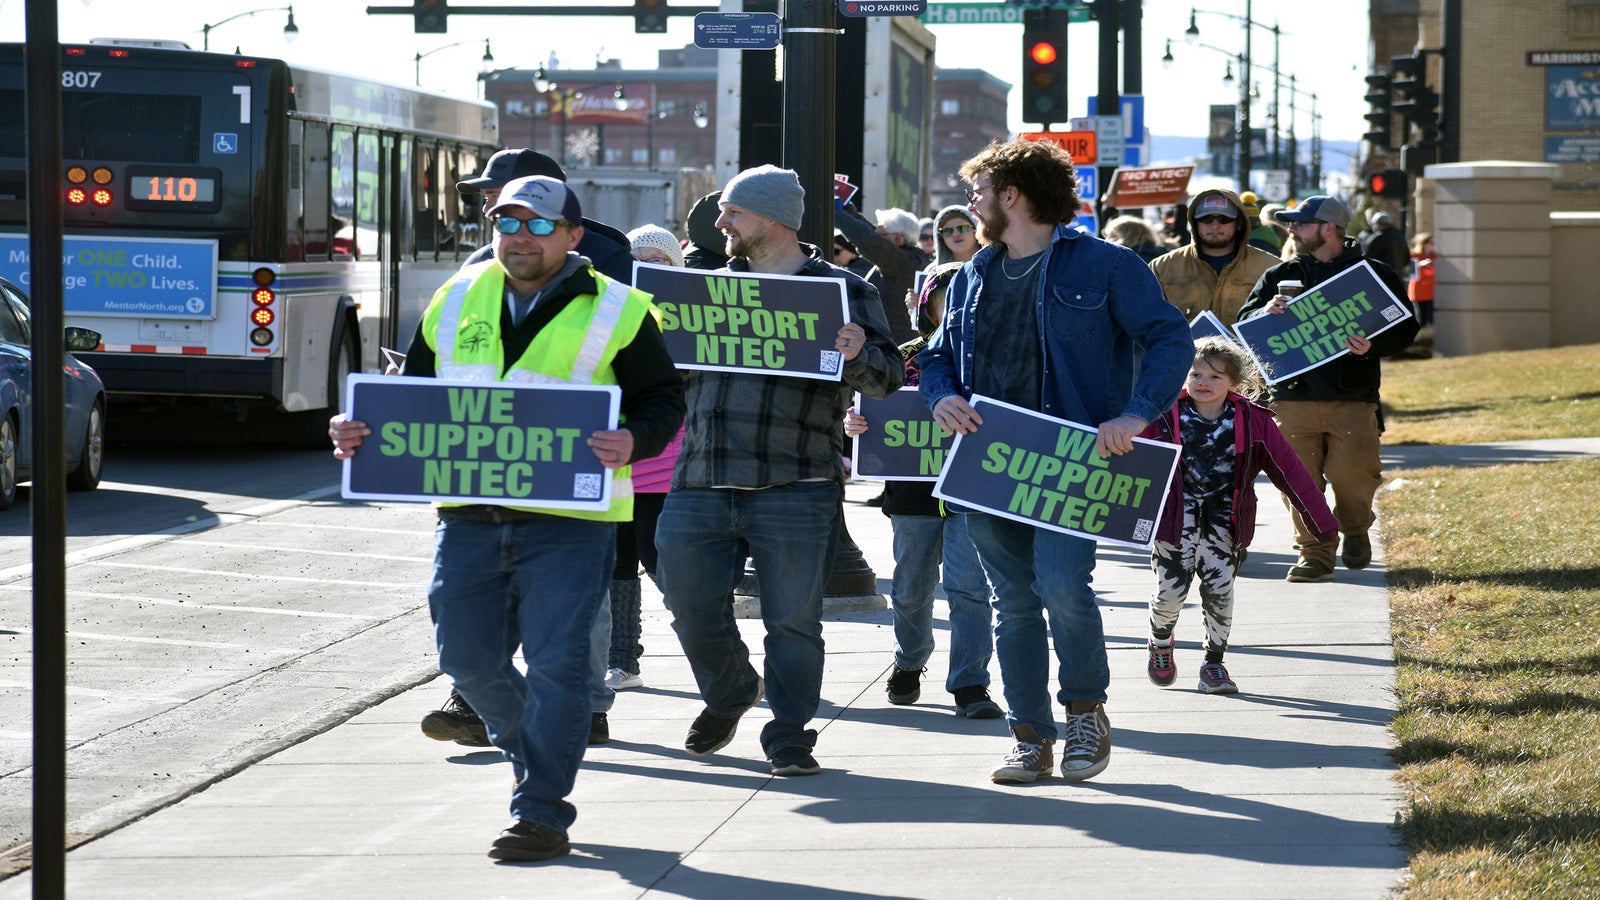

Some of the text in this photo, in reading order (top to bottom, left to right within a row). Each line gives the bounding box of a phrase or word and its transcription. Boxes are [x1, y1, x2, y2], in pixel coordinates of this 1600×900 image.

[860, 4, 919, 12] NO PARKING
[927, 4, 1025, 22] Hammo
[1532, 52, 1600, 64] HARRINGT
[61, 71, 102, 88] 807
[148, 176, 198, 201] 110
[1122, 171, 1147, 181] NO
[78, 249, 129, 267] ONE
[132, 254, 182, 269] Child.
[91, 270, 148, 289] TWO
[152, 276, 199, 290] Lives.
[704, 276, 762, 307] WE
[104, 301, 184, 313] MentorNorth.org
[656, 302, 819, 340] SUPPORT
[1288, 290, 1331, 322] WE
[1266, 290, 1373, 355] SUPPORT
[696, 334, 786, 369] NTEC
[1301, 321, 1366, 364] NTEC
[448, 387, 515, 424] WE
[379, 421, 581, 462] SUPPORT
[423, 459, 533, 498] NTEC
[981, 441, 1151, 509] SUPPORT
[1007, 482, 1110, 533] NTEC
